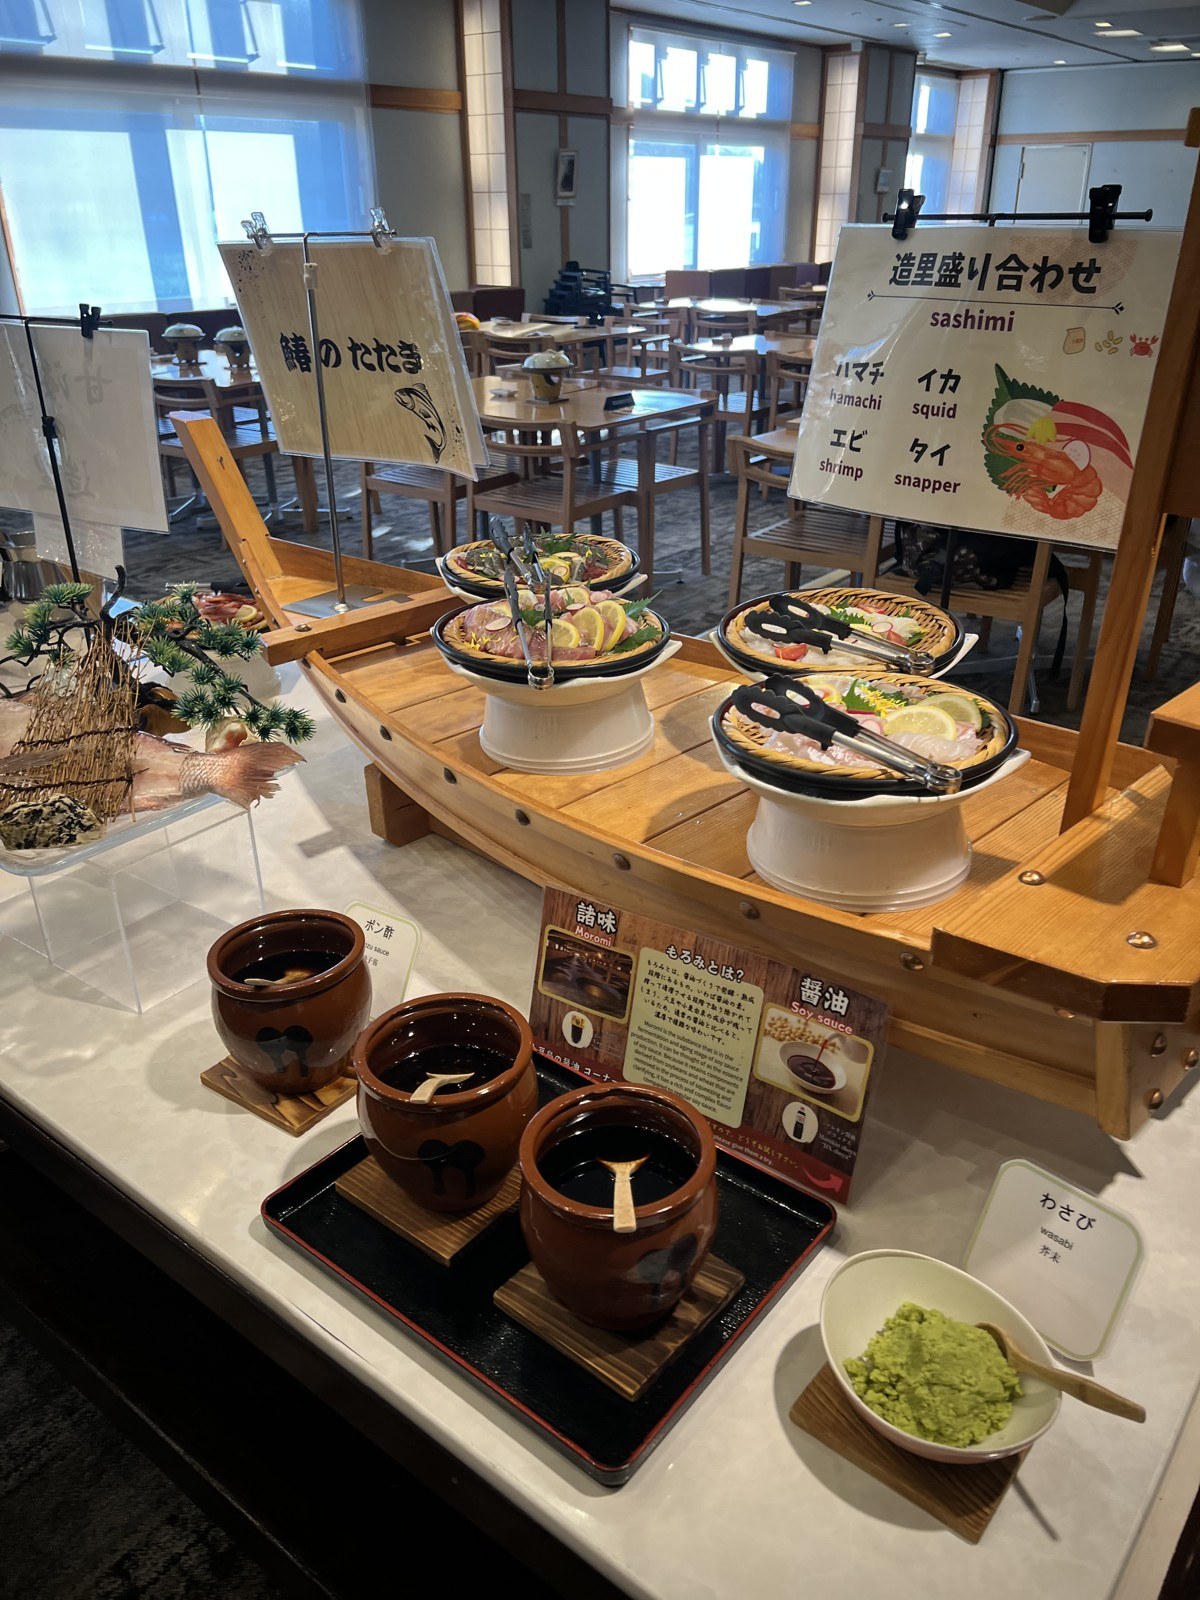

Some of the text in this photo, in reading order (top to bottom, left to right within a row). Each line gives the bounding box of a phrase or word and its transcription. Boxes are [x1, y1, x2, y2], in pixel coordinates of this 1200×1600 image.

[888, 252, 1102, 294] 造里盛り合わせ
[929, 309, 1016, 332] sashimi
[835, 359, 885, 386] ハマチ
[917, 367, 962, 395] イカ
[828, 388, 883, 411] hamachi
[911, 400, 958, 420] squid
[829, 429, 868, 453] エビ
[909, 437, 952, 467] タイ
[818, 458, 864, 481] shrimp
[894, 471, 962, 494] snapper
[364, 919, 395, 940] ポン酢
[576, 901, 617, 934] 諸味
[574, 925, 612, 947] Moromi
[374, 946, 389, 956] sauce
[800, 977, 849, 1016] 醤油
[790, 1001, 853, 1035] Soy sauce
[707, 1120, 799, 1169] すので、どうぞお試し下さい。
[1039, 1192, 1097, 1231] わさび
[1039, 1226, 1075, 1251] wasabi
